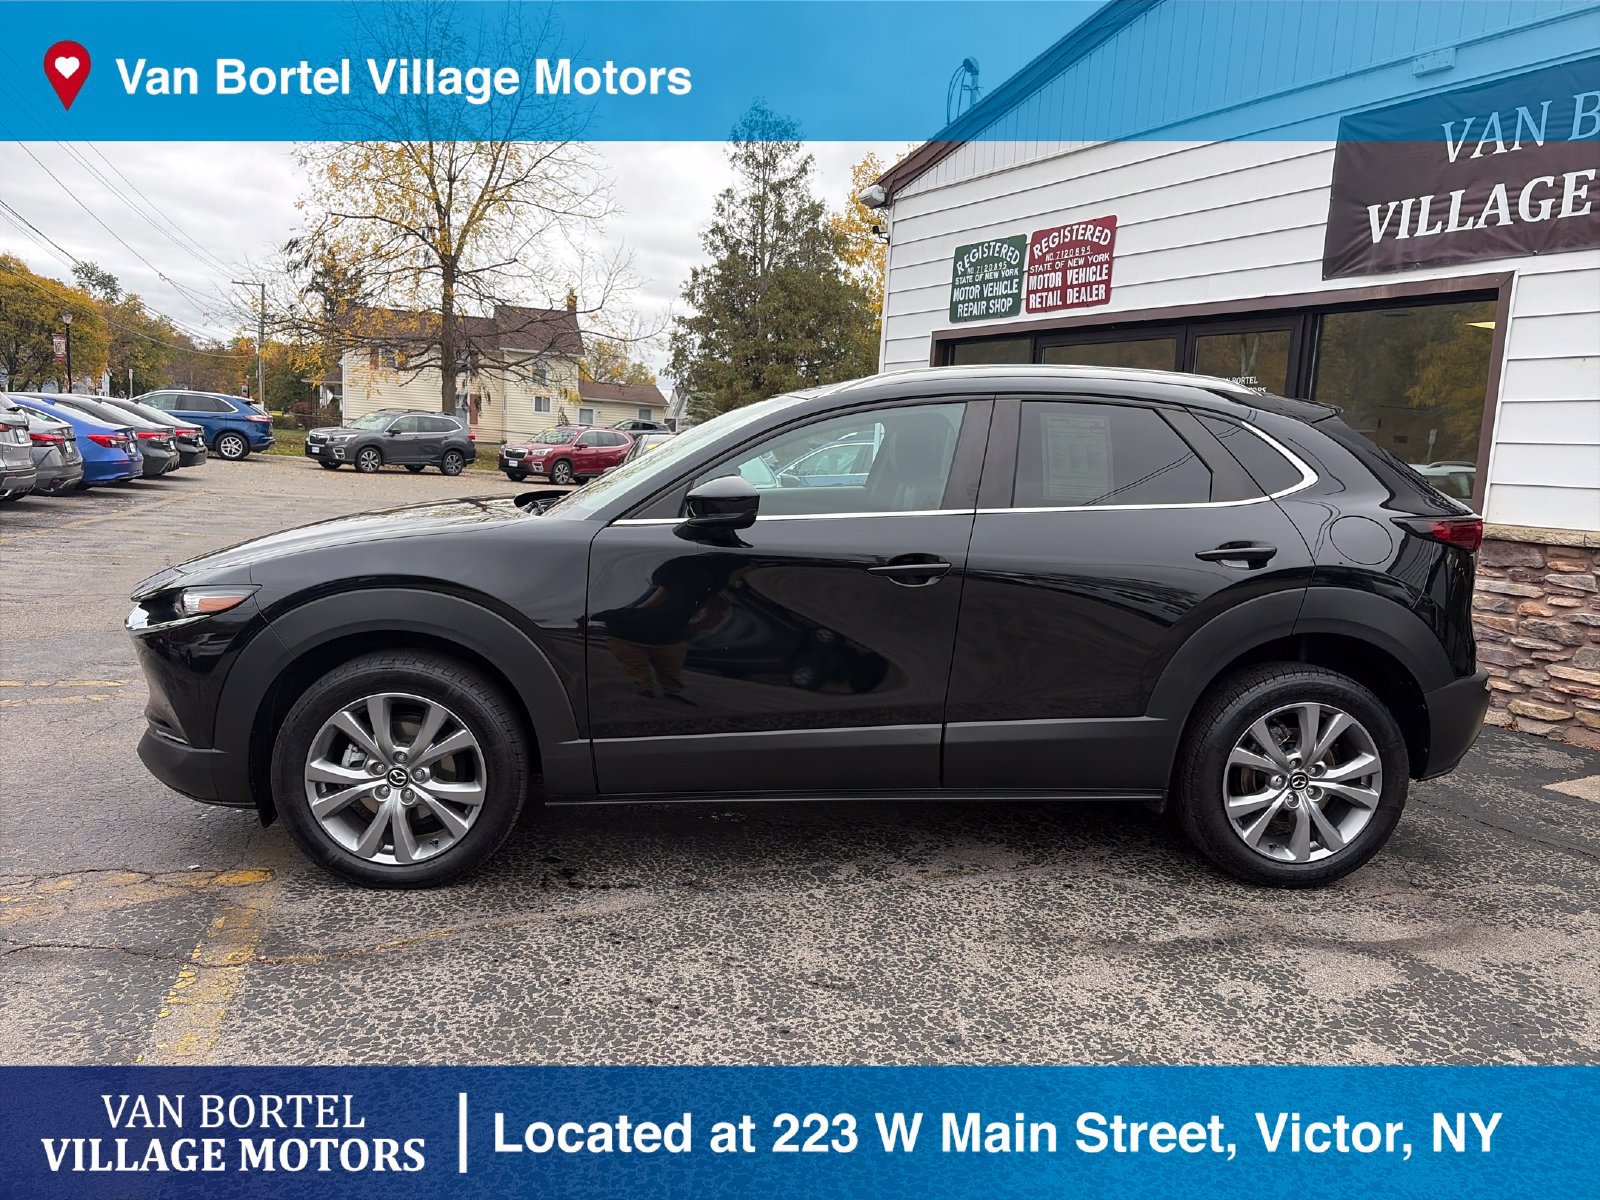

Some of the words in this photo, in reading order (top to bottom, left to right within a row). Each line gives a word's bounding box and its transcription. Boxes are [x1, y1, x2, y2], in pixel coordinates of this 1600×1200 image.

[1441, 100, 1552, 163] VAN
[1367, 168, 1596, 244] VILLAGE
[1033, 224, 1111, 259] REGISTERED
[1055, 245, 1093, 260] 7120895
[956, 242, 1020, 275] REGISTERED
[1029, 263, 1053, 273] STATE
[1055, 260, 1065, 270] OF
[1068, 257, 1085, 268] NEW
[1088, 252, 1110, 264] YORK
[955, 275, 974, 285] STATE
[975, 274, 984, 282] OF
[985, 271, 1000, 280] NEW
[1001, 268, 1019, 278] YORK
[1028, 271, 1062, 291] MOTOR
[1067, 264, 1109, 285] VEHICLE
[953, 285, 980, 302] MOTOR
[983, 279, 1019, 298] VEHICLE
[1029, 290, 1062, 309] RETAIL
[1066, 284, 1106, 305] DEALER
[957, 301, 987, 318] REPAIR
[989, 297, 1013, 314] SHOP
